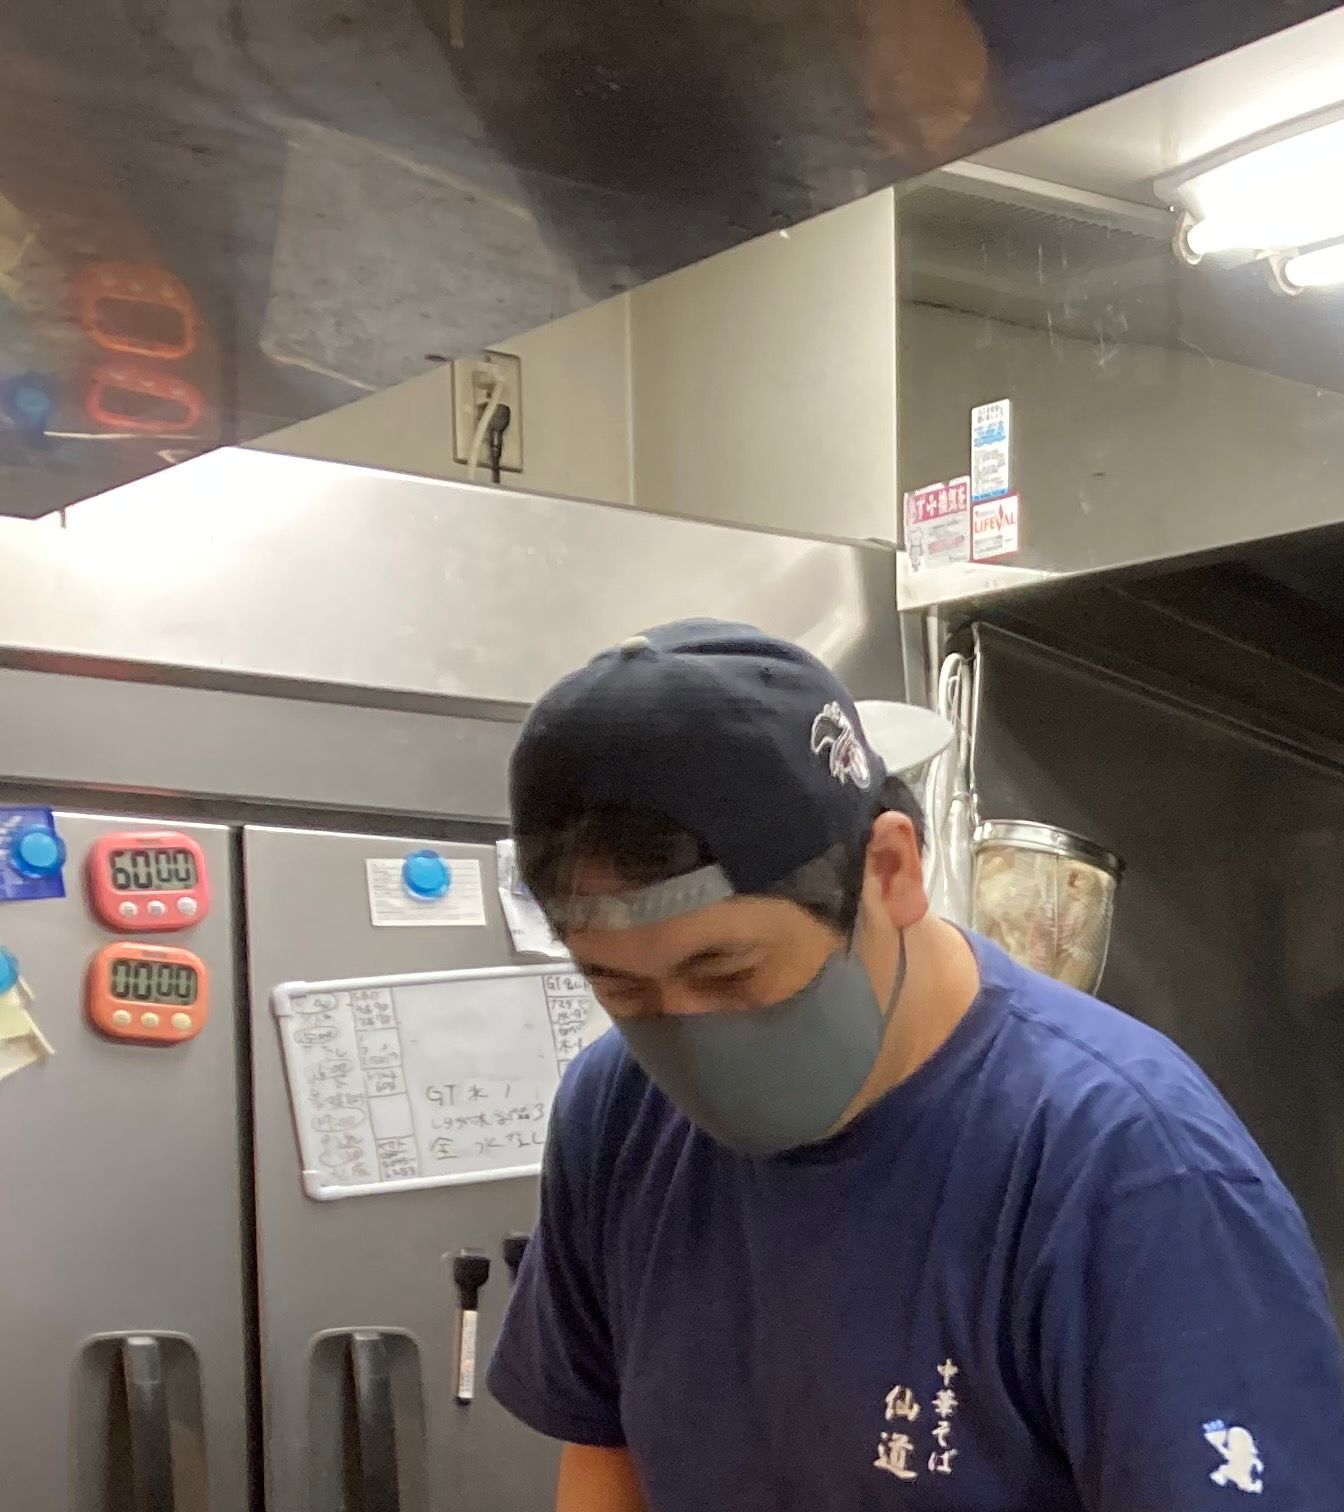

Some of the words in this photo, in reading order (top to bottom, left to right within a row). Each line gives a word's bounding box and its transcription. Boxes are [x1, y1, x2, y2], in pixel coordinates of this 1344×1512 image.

[974, 506, 1016, 535] LIFEVAL
[873, 1384, 922, 1480] 仙道
[927, 1358, 960, 1474] 中華そば
